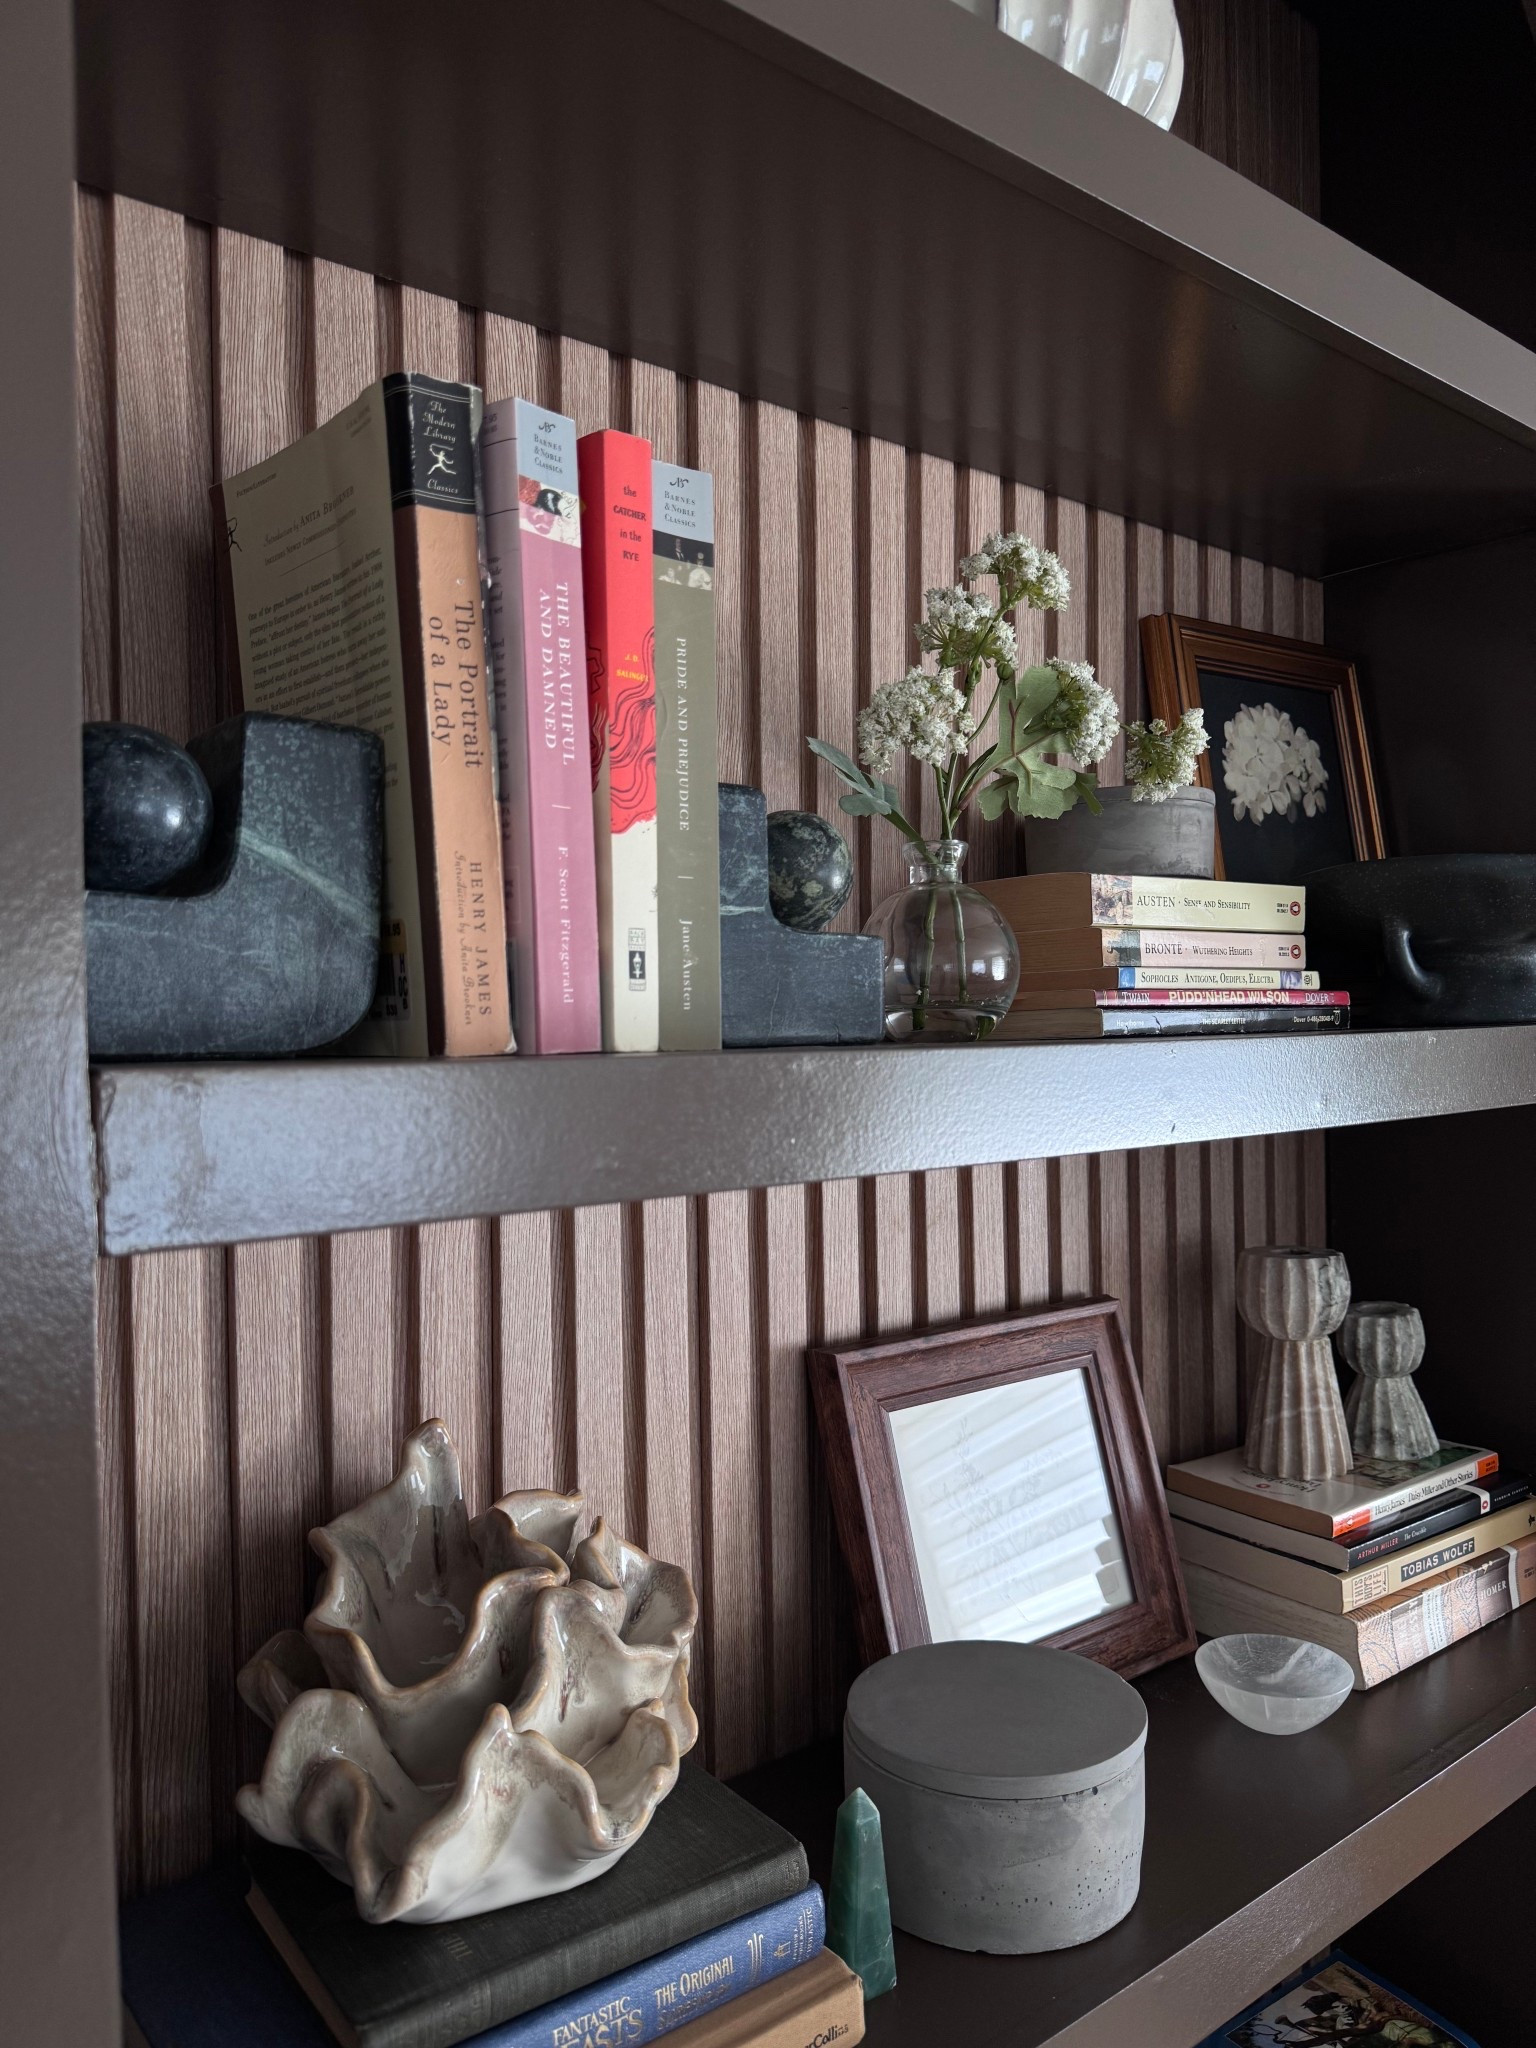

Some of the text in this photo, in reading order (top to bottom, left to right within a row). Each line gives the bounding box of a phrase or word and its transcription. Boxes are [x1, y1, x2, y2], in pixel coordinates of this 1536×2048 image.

[430, 400, 447, 414] The
[422, 412, 456, 430] Modern
[423, 426, 456, 445] Library
[534, 457, 563, 474] CLASSICS
[426, 478, 459, 495] Classics
[623, 485, 637, 498] the
[664, 490, 696, 506] BARNES
[300, 511, 321, 528] ANITA
[613, 504, 647, 522] CATCHER
[664, 513, 696, 528] CLASSICS
[619, 528, 642, 542] in the
[623, 550, 640, 561] RYE
[539, 587, 557, 750] AND DAMNED
[556, 582, 575, 766] THE BEAUTIFUL
[428, 616, 456, 747] of a Lady
[454, 600, 484, 768] The Portrait
[675, 637, 690, 831] PRIDE AND PREJUDICE
[453, 850, 467, 919] Introduction
[1136, 895, 1176, 908] AUSTEN
[1203, 900, 1216, 908] AND
[1217, 899, 1251, 910] SENSIBILITY
[457, 922, 470, 934] by
[558, 846, 574, 1004] F. Scott Fitzgerald
[469, 861, 492, 1016] HENRY JAMES
[460, 938, 473, 973] Anita
[1192, 945, 1228, 956] WUTHERING
[1228, 946, 1253, 956] HEIGHTS
[679, 918, 693, 1011] Jane Austen
[1141, 971, 1274, 985] SOPHOCLES ANTIGONE, OEDIPUS, ELECTRA
[1121, 991, 1329, 1003] TWAIN PUDD'NHEAD WILSON DOVER
[1408, 1492, 1421, 1505] Daisy
[1421, 1486, 1435, 1499] Miller
[1435, 1482, 1444, 1492] and
[1444, 1478, 1458, 1490] Other
[1457, 1471, 1474, 1484] Stories
[1357, 1545, 1379, 1560] ARTHUR
[1380, 1537, 1399, 1552] MILLER
[1403, 1533, 1411, 1541] The
[1402, 1540, 1474, 1577] TOBIAS WOLFF
[1354, 1578, 1364, 1603] THIS
[1372, 1571, 1382, 1597] LIFE
[1481, 1580, 1507, 1600] HOMER
[654, 1983, 679, 2010] THE
[679, 1955, 735, 1997] ORIGINAL
[552, 1996, 630, 2046] FANTASTIC
